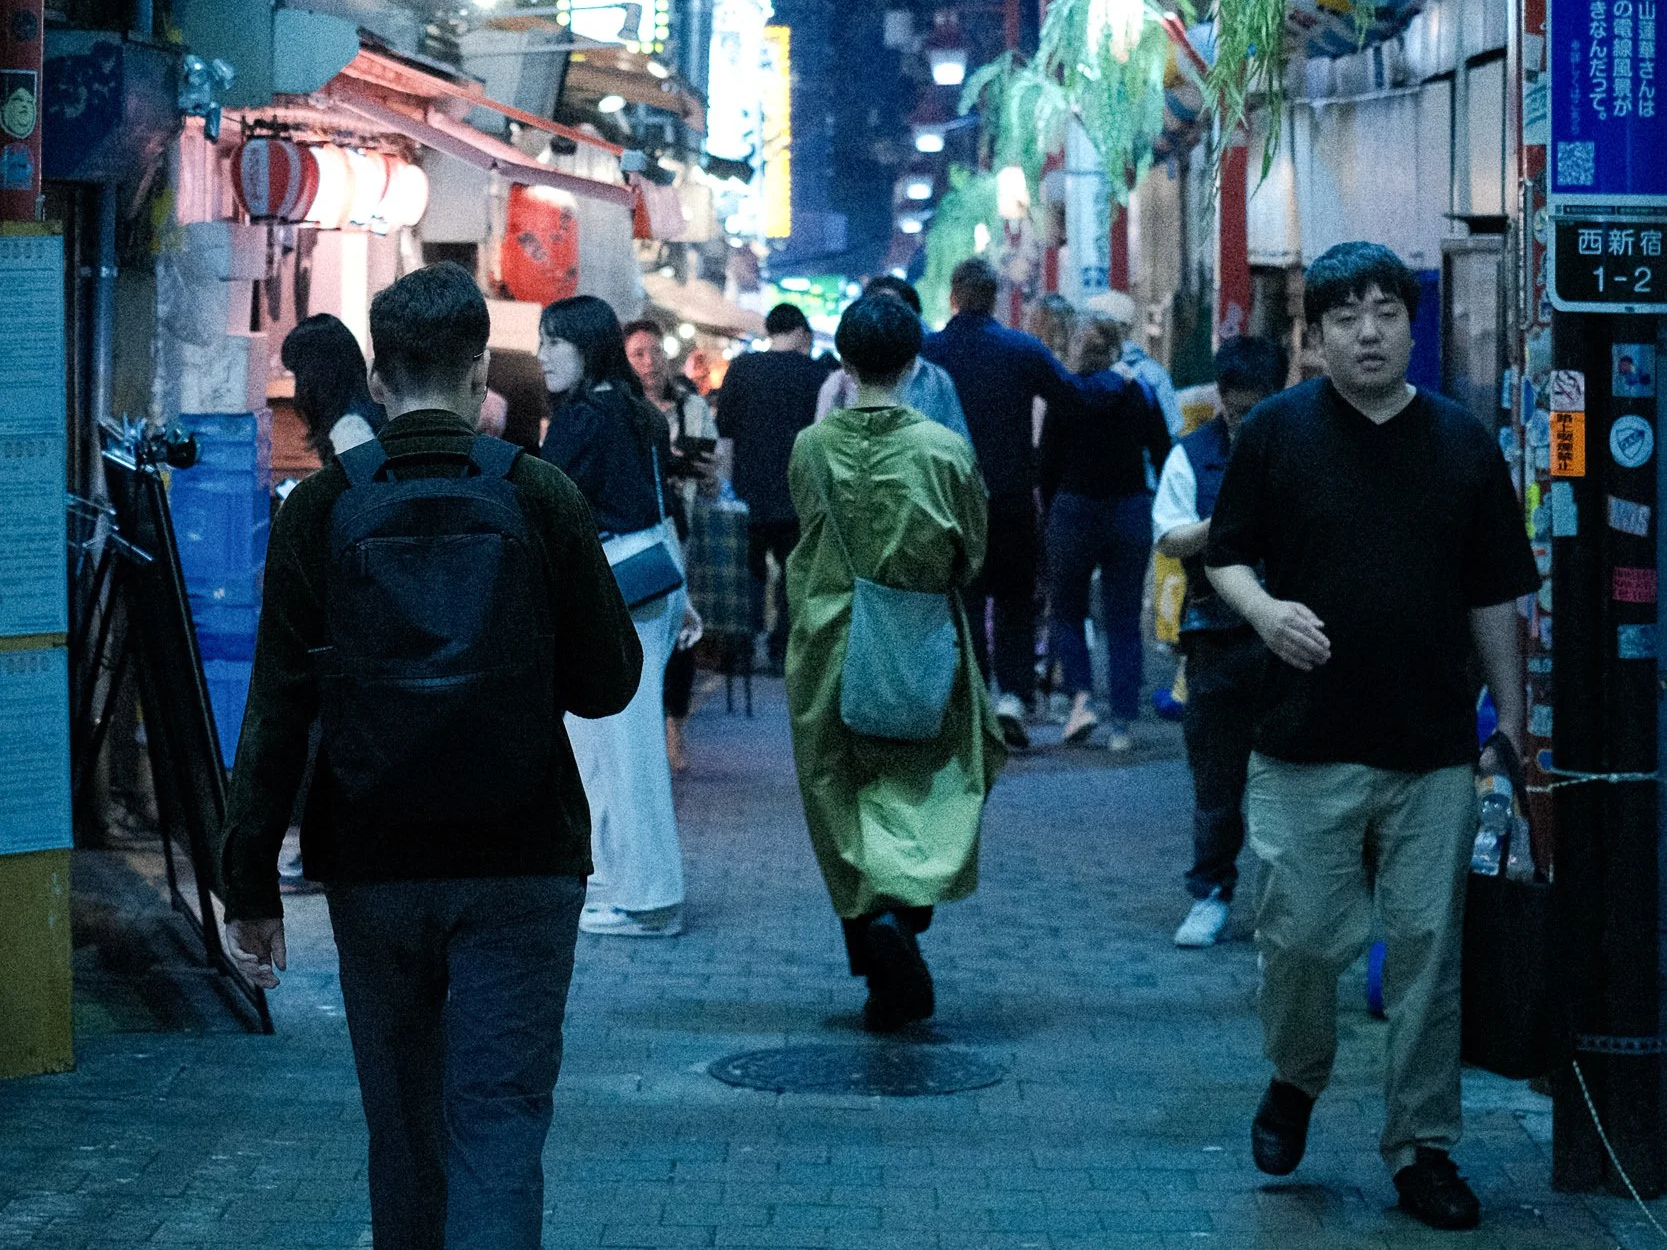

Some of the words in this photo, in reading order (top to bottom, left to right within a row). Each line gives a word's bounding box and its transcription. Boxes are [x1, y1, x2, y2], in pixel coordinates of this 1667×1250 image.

[1578, 229, 1662, 256] 西新宿
[1593, 266, 1652, 292] 1-2
